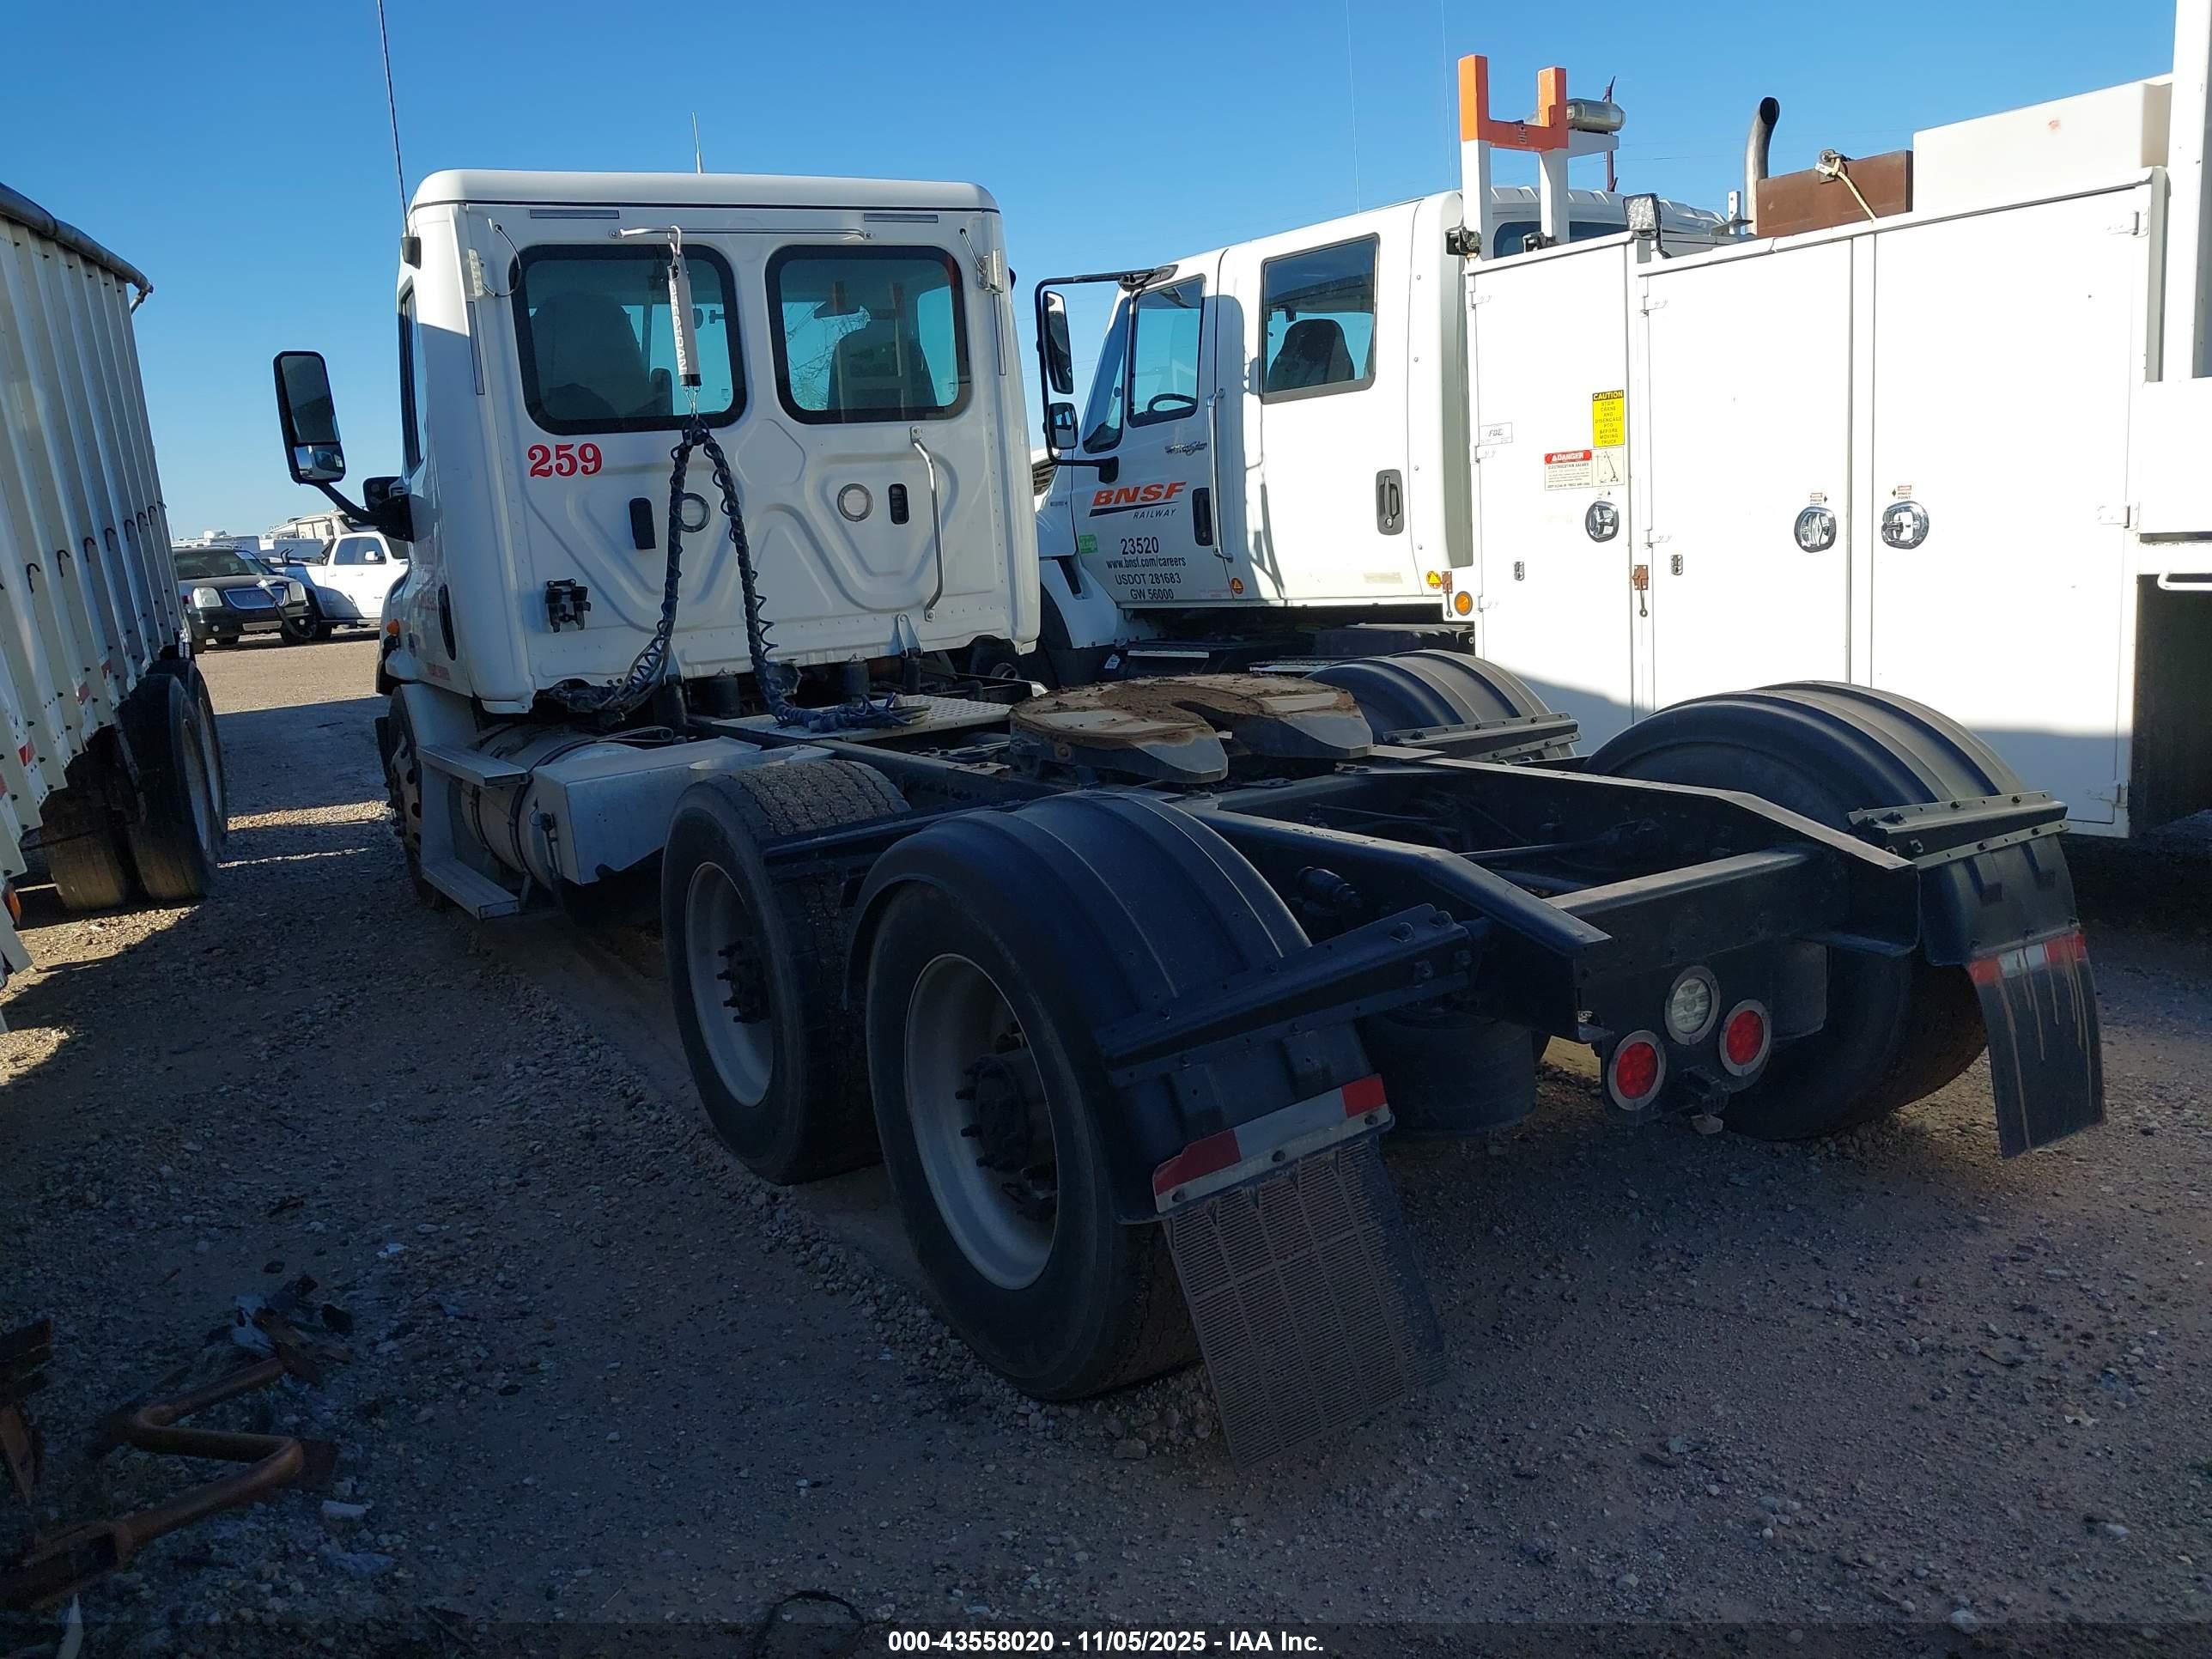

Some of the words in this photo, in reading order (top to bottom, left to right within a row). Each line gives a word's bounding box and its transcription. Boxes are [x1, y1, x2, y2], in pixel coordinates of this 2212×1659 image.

[1593, 391, 1623, 400] CAUTION
[527, 442, 603, 477] 259
[1557, 452, 1584, 461] DANGER
[1092, 481, 1187, 507] BNSF
[1133, 508, 1176, 519] RAILWAY
[1120, 537, 1159, 555] 23520
[1106, 556, 1187, 569] www.bnsf.com/careers
[1115, 574, 1146, 585] USDOT
[1149, 573, 1182, 584] 281683
[1130, 588, 1146, 599] GW
[1147, 588, 1174, 599] 56000
